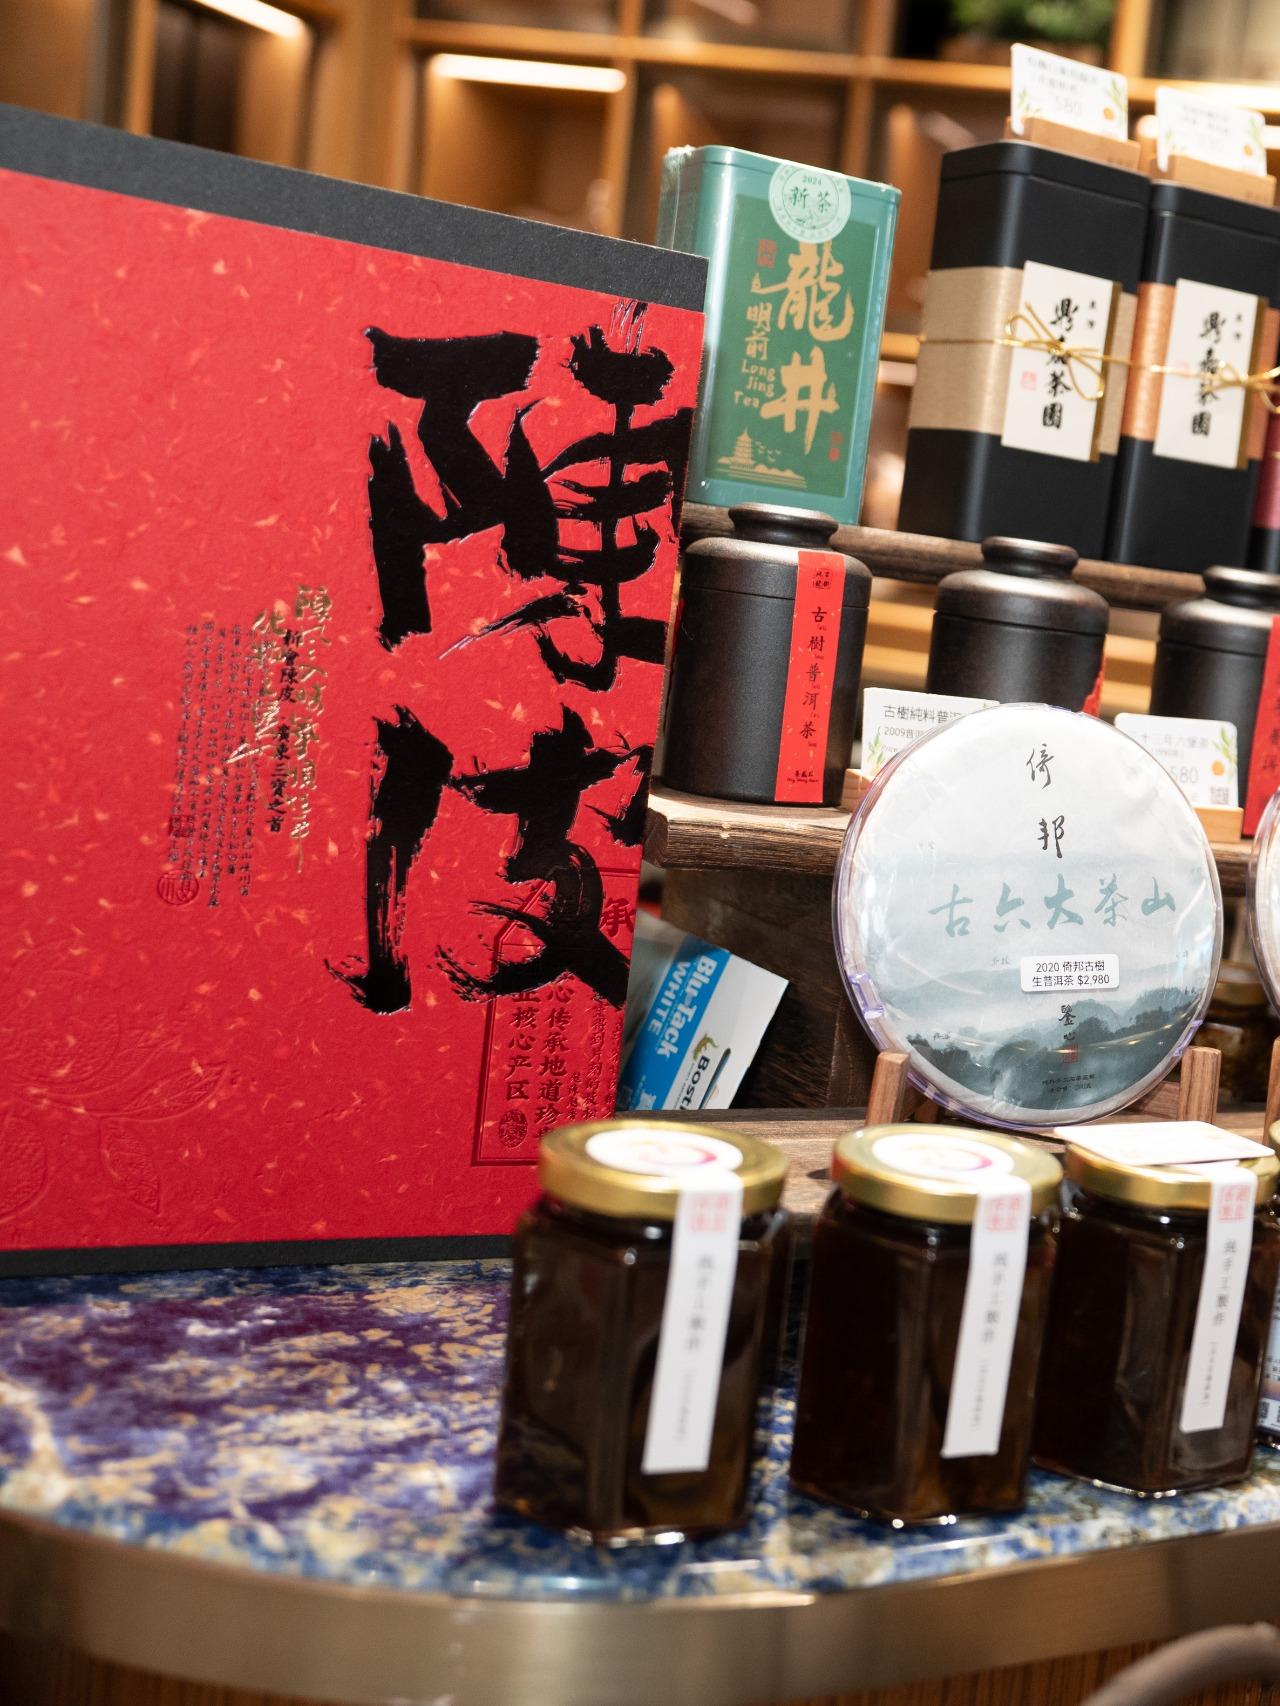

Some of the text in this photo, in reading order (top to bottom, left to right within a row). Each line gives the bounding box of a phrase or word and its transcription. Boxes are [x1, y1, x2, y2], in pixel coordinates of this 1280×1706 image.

[746, 303, 772, 361] 明前
[751, 240, 855, 455] 龍井
[734, 391, 760, 408] Tea
[741, 358, 776, 381] Long
[799, 605, 829, 741] 古樹普洱茶
[1025, 742, 1066, 859] 倚邦
[927, 872, 1178, 938] 古六大茶山
[648, 961, 692, 1036] WHITE
[1032, 974, 1110, 987] 生普洱茶 $2,980
[1035, 960, 1105, 973] 2020 倚邦古樹
[657, 955, 718, 1060] Blu-Tack
